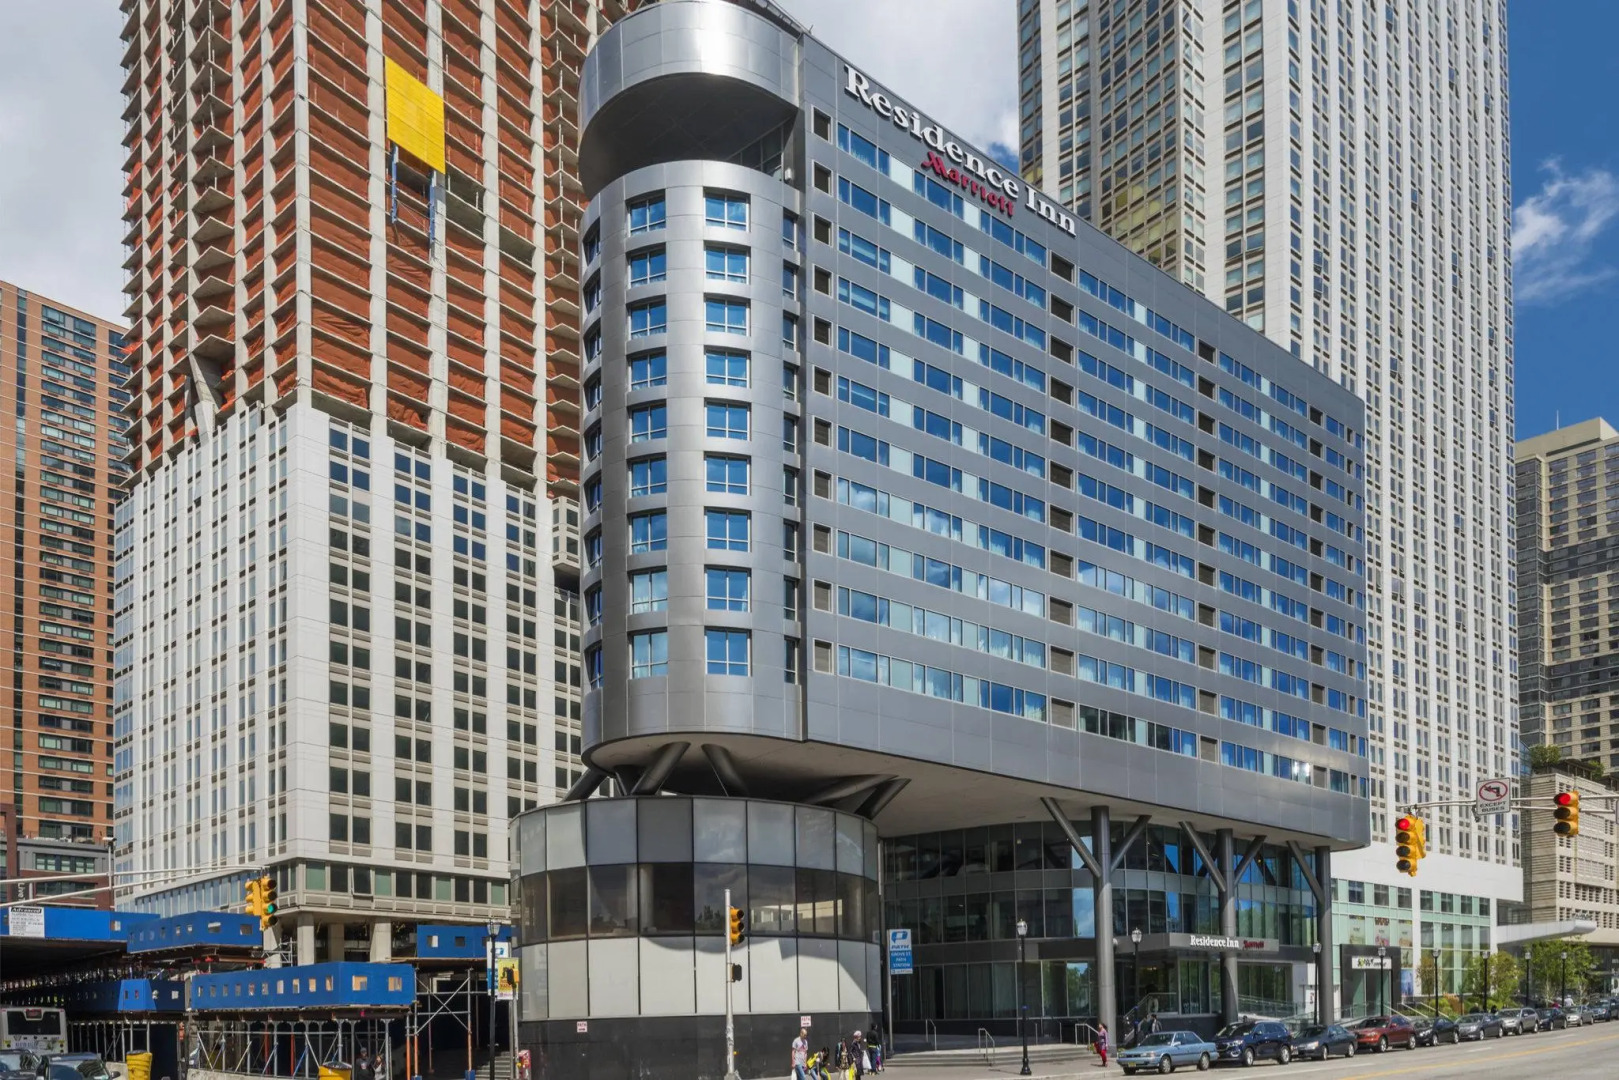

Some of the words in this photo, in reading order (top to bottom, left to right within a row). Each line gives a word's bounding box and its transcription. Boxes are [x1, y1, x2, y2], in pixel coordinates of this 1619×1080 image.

[844, 64, 1019, 199] Residence
[1025, 185, 1077, 237] Inn
[921, 151, 1014, 217] Marriott
[1190, 935, 1226, 947] Residence
[1226, 937, 1240, 948] Inn
